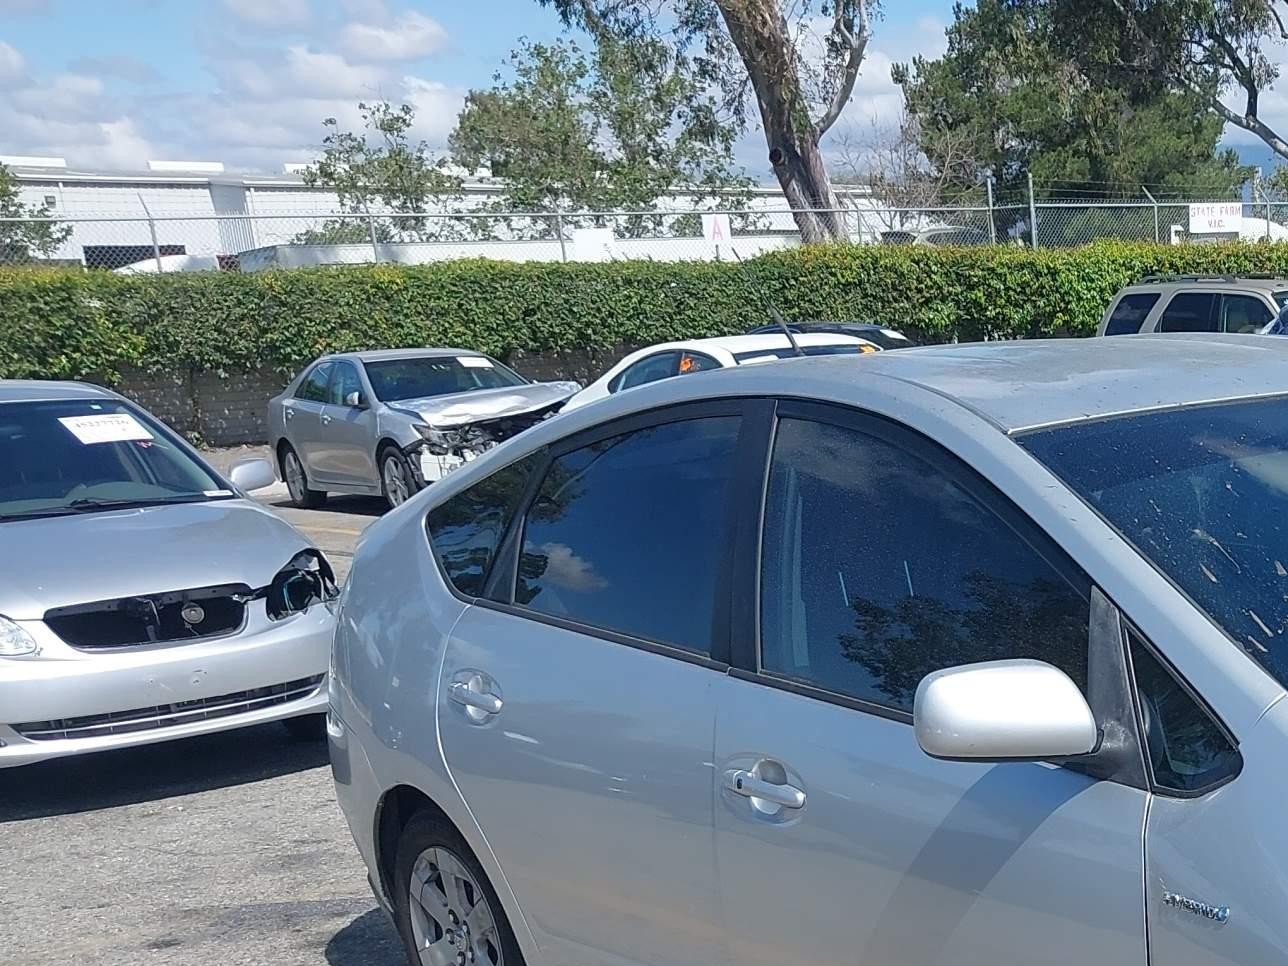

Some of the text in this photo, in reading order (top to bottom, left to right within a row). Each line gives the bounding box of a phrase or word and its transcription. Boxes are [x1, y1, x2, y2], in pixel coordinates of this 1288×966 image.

[1190, 206, 1241, 217] STATE FARM
[711, 215, 724, 240] A
